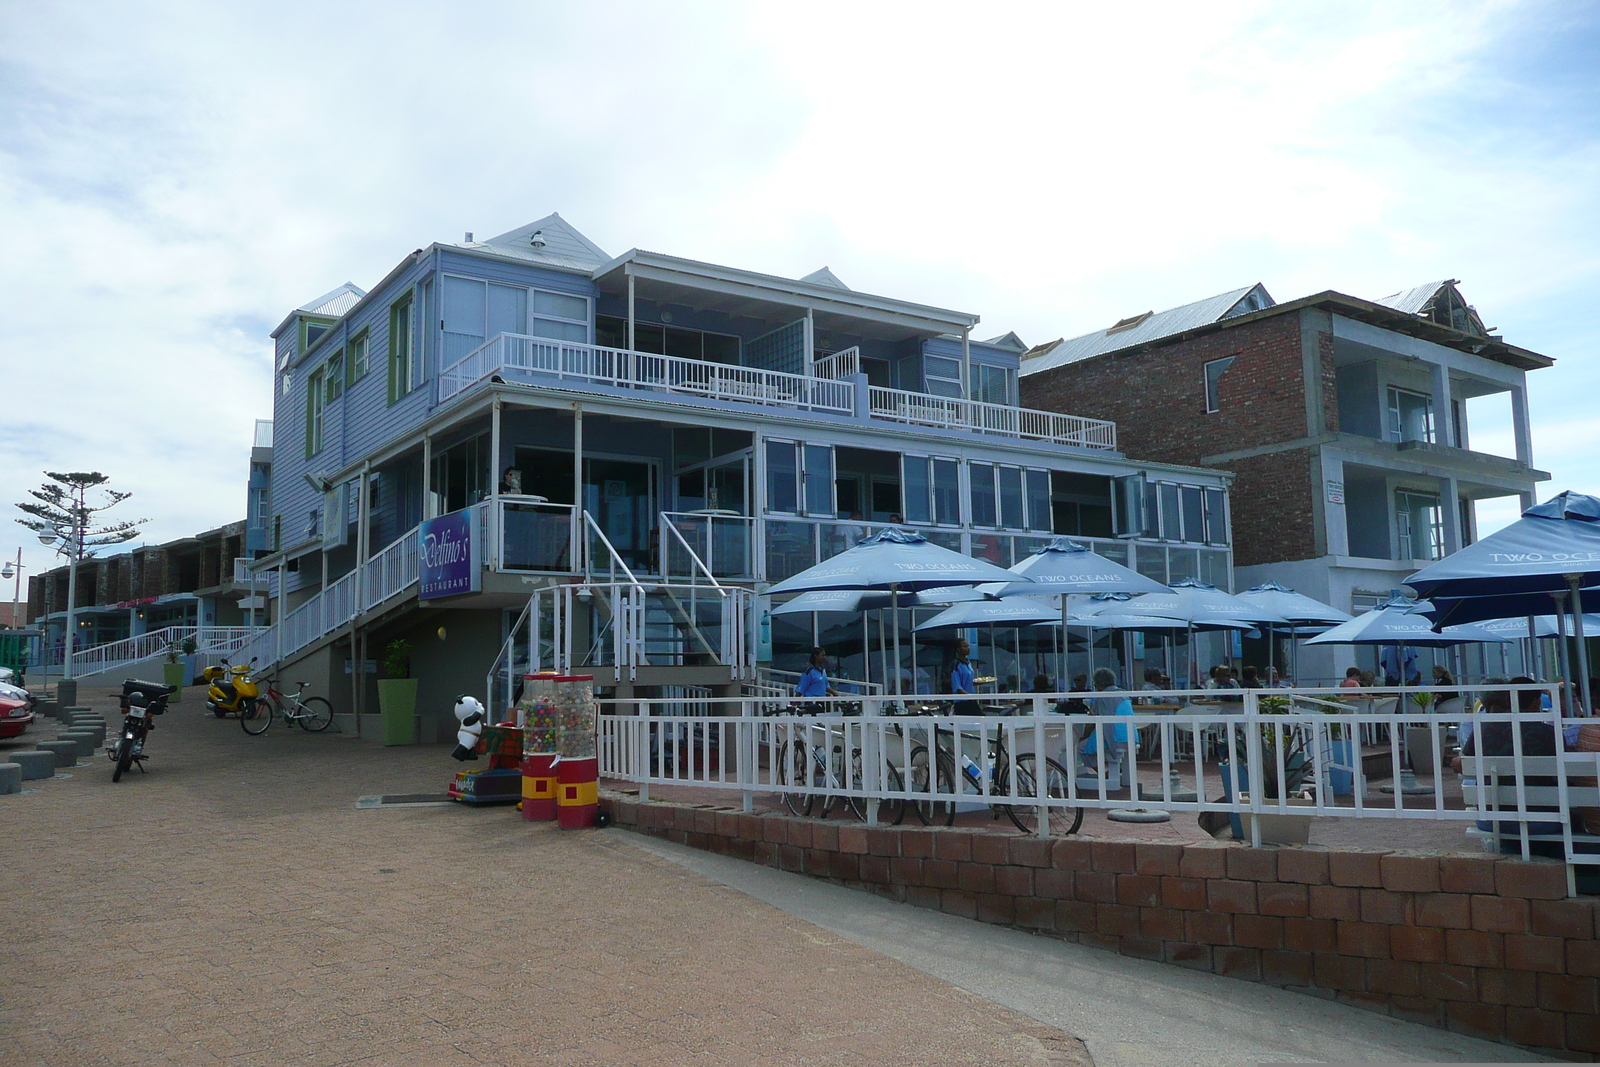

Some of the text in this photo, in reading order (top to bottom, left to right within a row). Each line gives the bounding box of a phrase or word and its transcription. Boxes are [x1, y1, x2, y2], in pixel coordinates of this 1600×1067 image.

[420, 525, 468, 579] Delfino's
[1489, 553, 1543, 562] TWO
[1069, 574, 1122, 582] OCEANS
[421, 577, 468, 593] RESTAURANT
[1487, 621, 1528, 629] OCEANS
